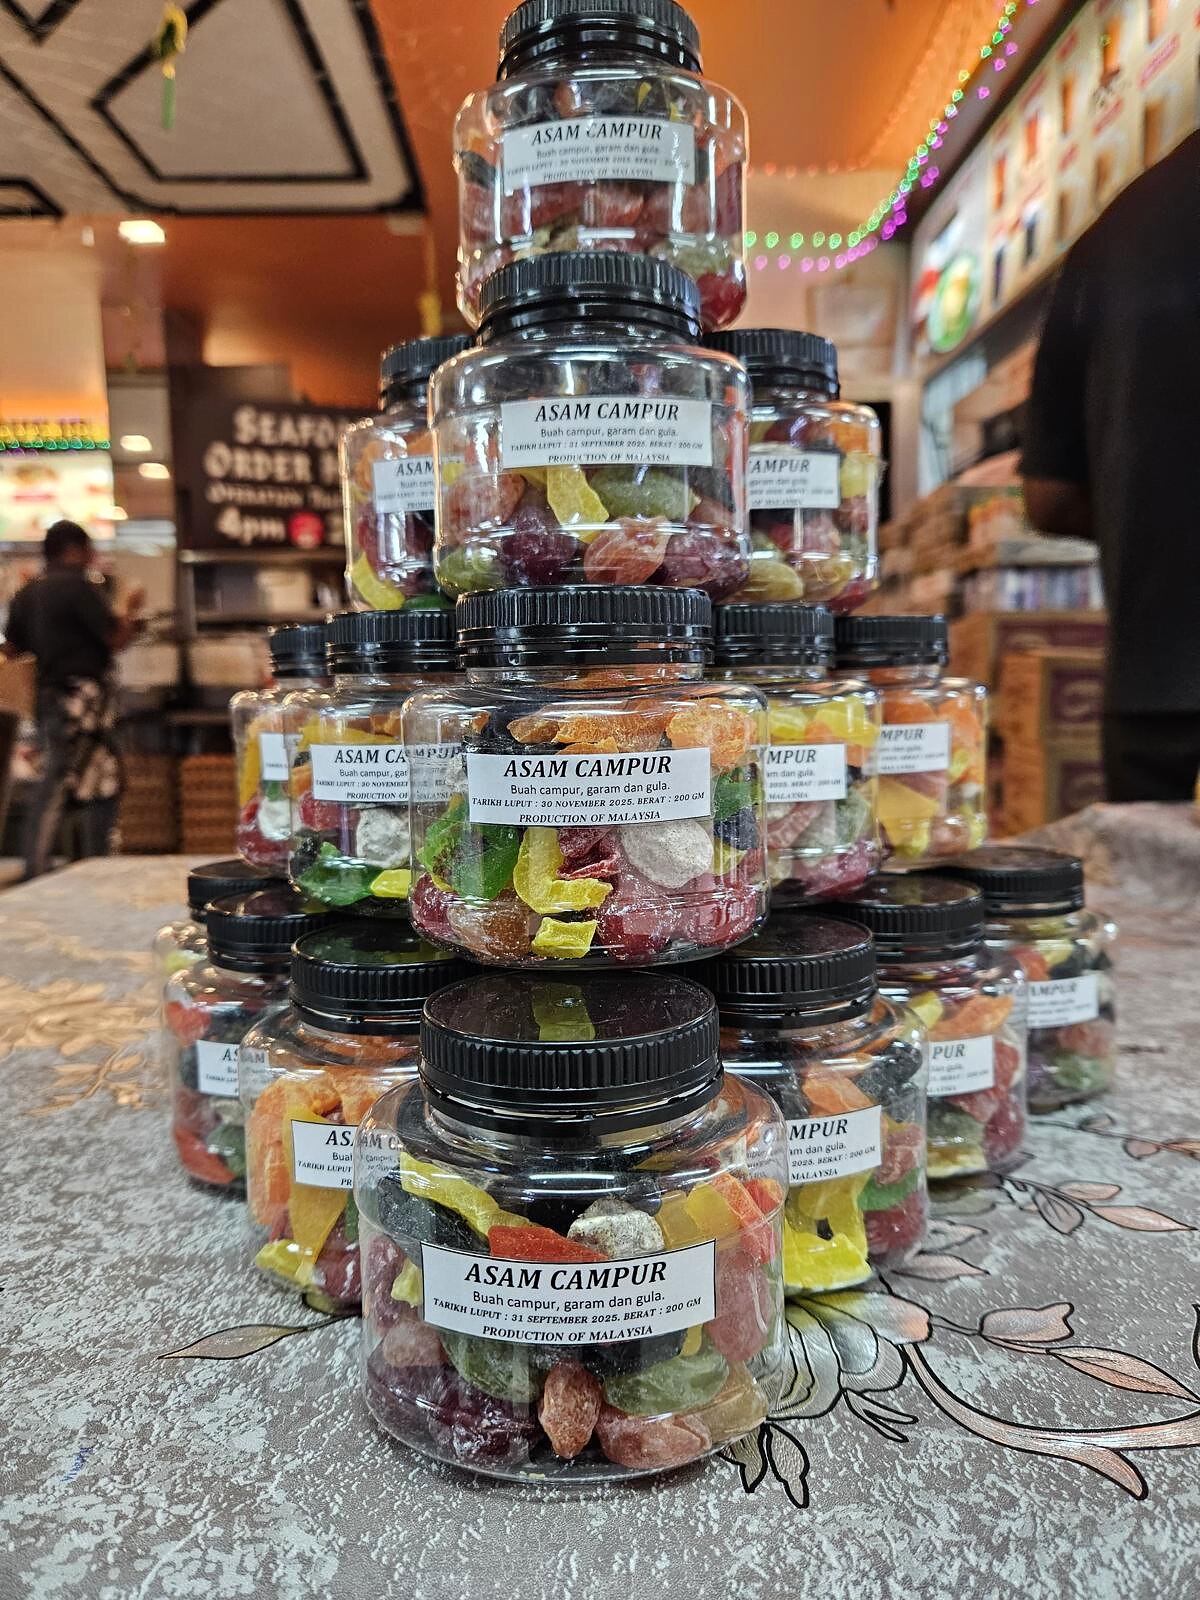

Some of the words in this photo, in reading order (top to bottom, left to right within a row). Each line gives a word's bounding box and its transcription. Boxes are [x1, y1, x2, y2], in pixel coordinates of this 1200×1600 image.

[531, 124, 580, 146] ASAM
[586, 121, 662, 140] CAMPUR
[535, 403, 591, 422] ASAM
[597, 402, 679, 421] CAMPUR
[540, 428, 564, 438] Buah
[566, 429, 604, 440] campur,
[607, 428, 636, 438] garam
[639, 427, 656, 436] dan
[511, 443, 537, 452] TARIKH
[538, 442, 562, 450] LUPUT
[580, 440, 625, 448] SEPTEMBER
[548, 452, 607, 463] PRODUCTION
[610, 452, 621, 461] OF
[626, 452, 670, 463] MALAYSIA
[396, 460, 435, 477] ASAM
[750, 459, 810, 473] AMPUR
[881, 728, 924, 741] MPUR
[334, 749, 380, 764] ASAM
[766, 749, 817, 764] MPUR
[339, 769, 358, 777] Buah
[360, 769, 393, 779] campur,
[503, 759, 568, 778] ASAM
[575, 755, 672, 778] CAMPUR
[346, 791, 396, 800] PRODUCTION
[510, 784, 537, 794] Buah
[539, 784, 584, 797] campur,
[587, 784, 621, 797] garam
[623, 782, 643, 793] dan
[646, 781, 670, 794] gula.
[472, 797, 502, 807] TARIKH
[504, 799, 532, 808] LUPUT
[541, 800, 553, 808] 30
[555, 799, 606, 808] NOVEMBER
[609, 798, 635, 807] 2025.
[637, 795, 667, 806] BERAT
[674, 794, 689, 802] 200
[691, 792, 705, 801] GM
[518, 813, 587, 824] PRODUCTION
[591, 813, 605, 823] OF
[607, 811, 661, 822] MALAYSIA
[932, 1043, 965, 1059] PUR
[789, 1118, 848, 1141] MPUR
[805, 1144, 823, 1154] dan
[825, 1141, 847, 1153] gula.
[791, 1159, 815, 1167] 2025.
[817, 1155, 844, 1165] BERAT
[849, 1151, 863, 1159] 200
[864, 1145, 876, 1155] GM
[297, 1160, 325, 1171] TARIKH
[327, 1165, 352, 1173] LUPUT
[790, 1168, 838, 1181] MALAYSIA
[464, 1263, 542, 1290] ASAM
[550, 1261, 667, 1290] CAMPUR
[473, 1290, 504, 1306] Buah
[507, 1298, 560, 1312] campur,
[564, 1298, 605, 1313] garam
[608, 1295, 633, 1308] dan
[636, 1290, 665, 1307] gula.
[433, 1298, 468, 1314] TARIKH
[470, 1308, 502, 1320] LUPUT
[511, 1314, 524, 1322] 31
[527, 1315, 588, 1324] SEPTEMBER
[591, 1313, 620, 1323] 2025.
[623, 1308, 657, 1321] BERAT
[665, 1304, 685, 1314] 200
[686, 1297, 702, 1309] GM
[482, 1325, 564, 1342] PRODUCTION
[568, 1331, 586, 1342] OF
[589, 1325, 653, 1341] MALAYSIA
